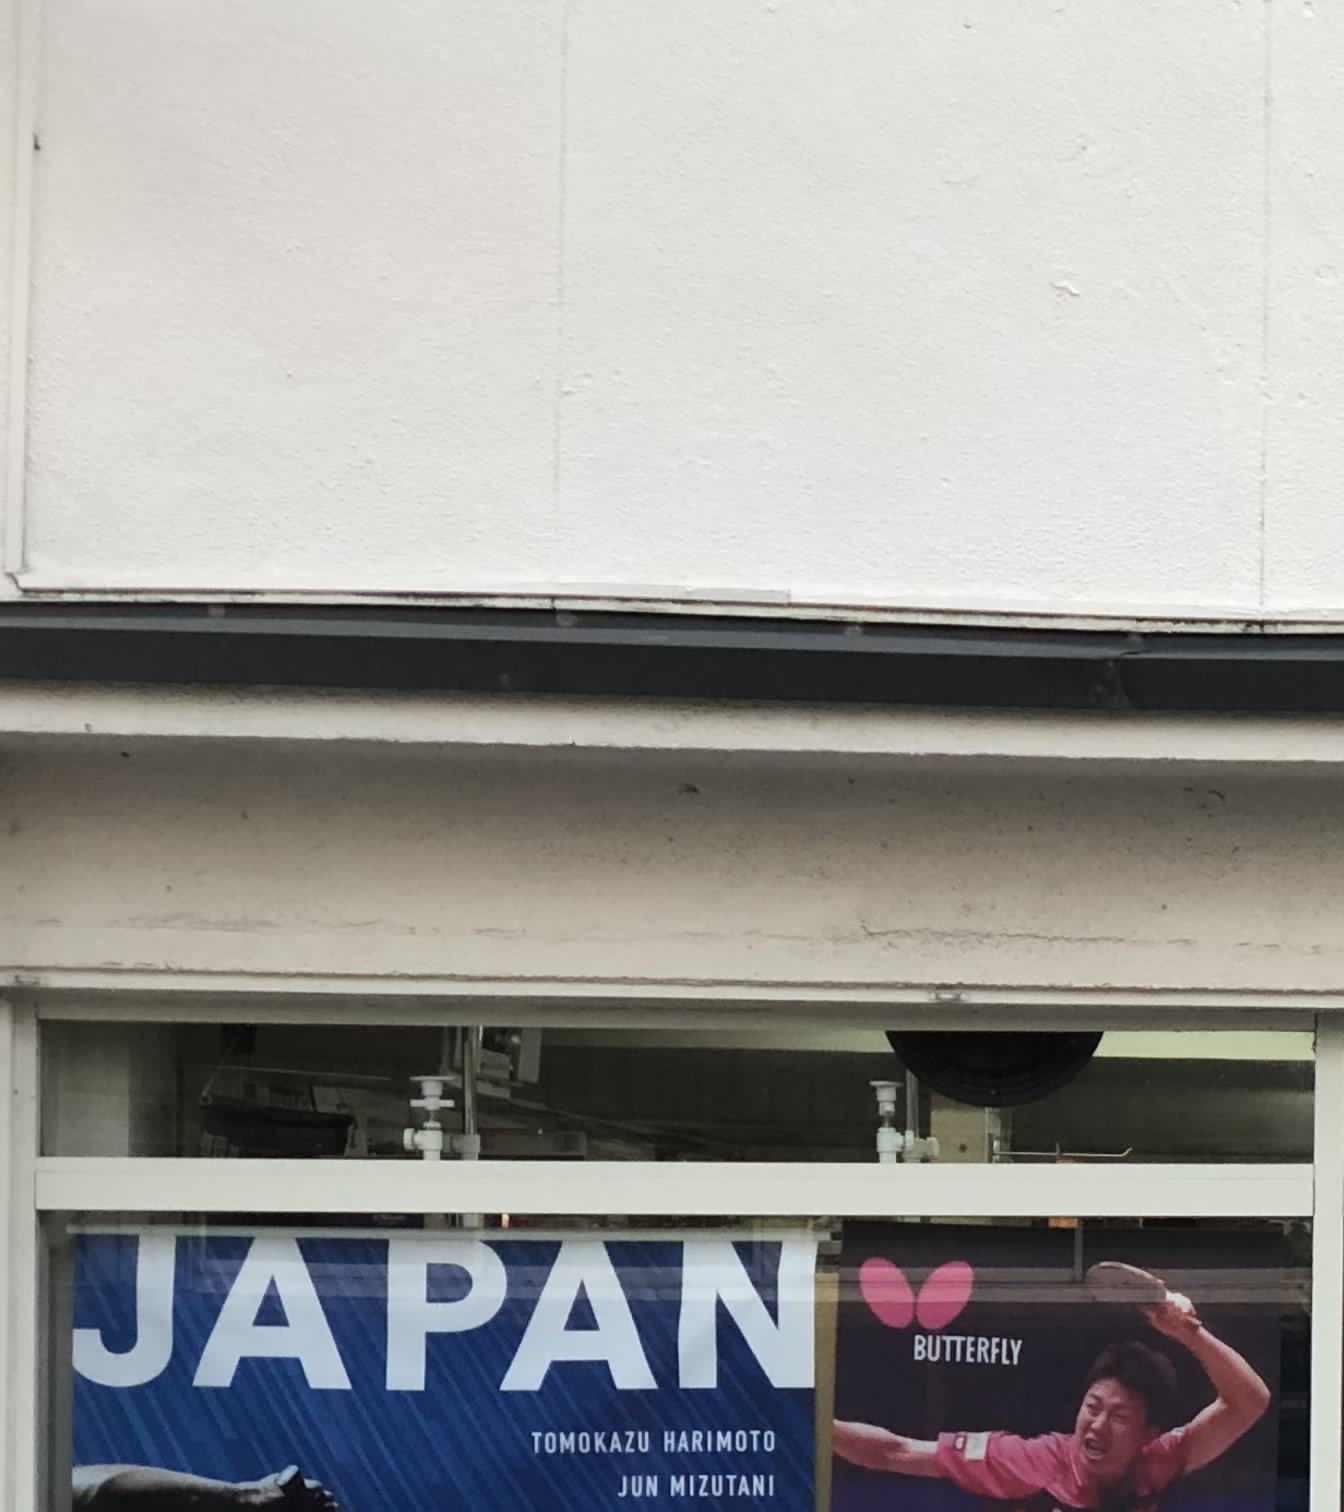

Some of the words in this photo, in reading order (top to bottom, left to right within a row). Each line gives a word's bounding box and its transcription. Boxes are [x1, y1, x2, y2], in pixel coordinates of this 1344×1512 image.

[72, 1234, 816, 1391] JAPAN
[913, 1335, 1022, 1367] BUTTERFLY
[532, 1431, 651, 1454] TOMOKAZU
[664, 1430, 776, 1453] HARIMOTO
[618, 1475, 659, 1498] JUN
[670, 1474, 775, 1498] MIZUTANI
